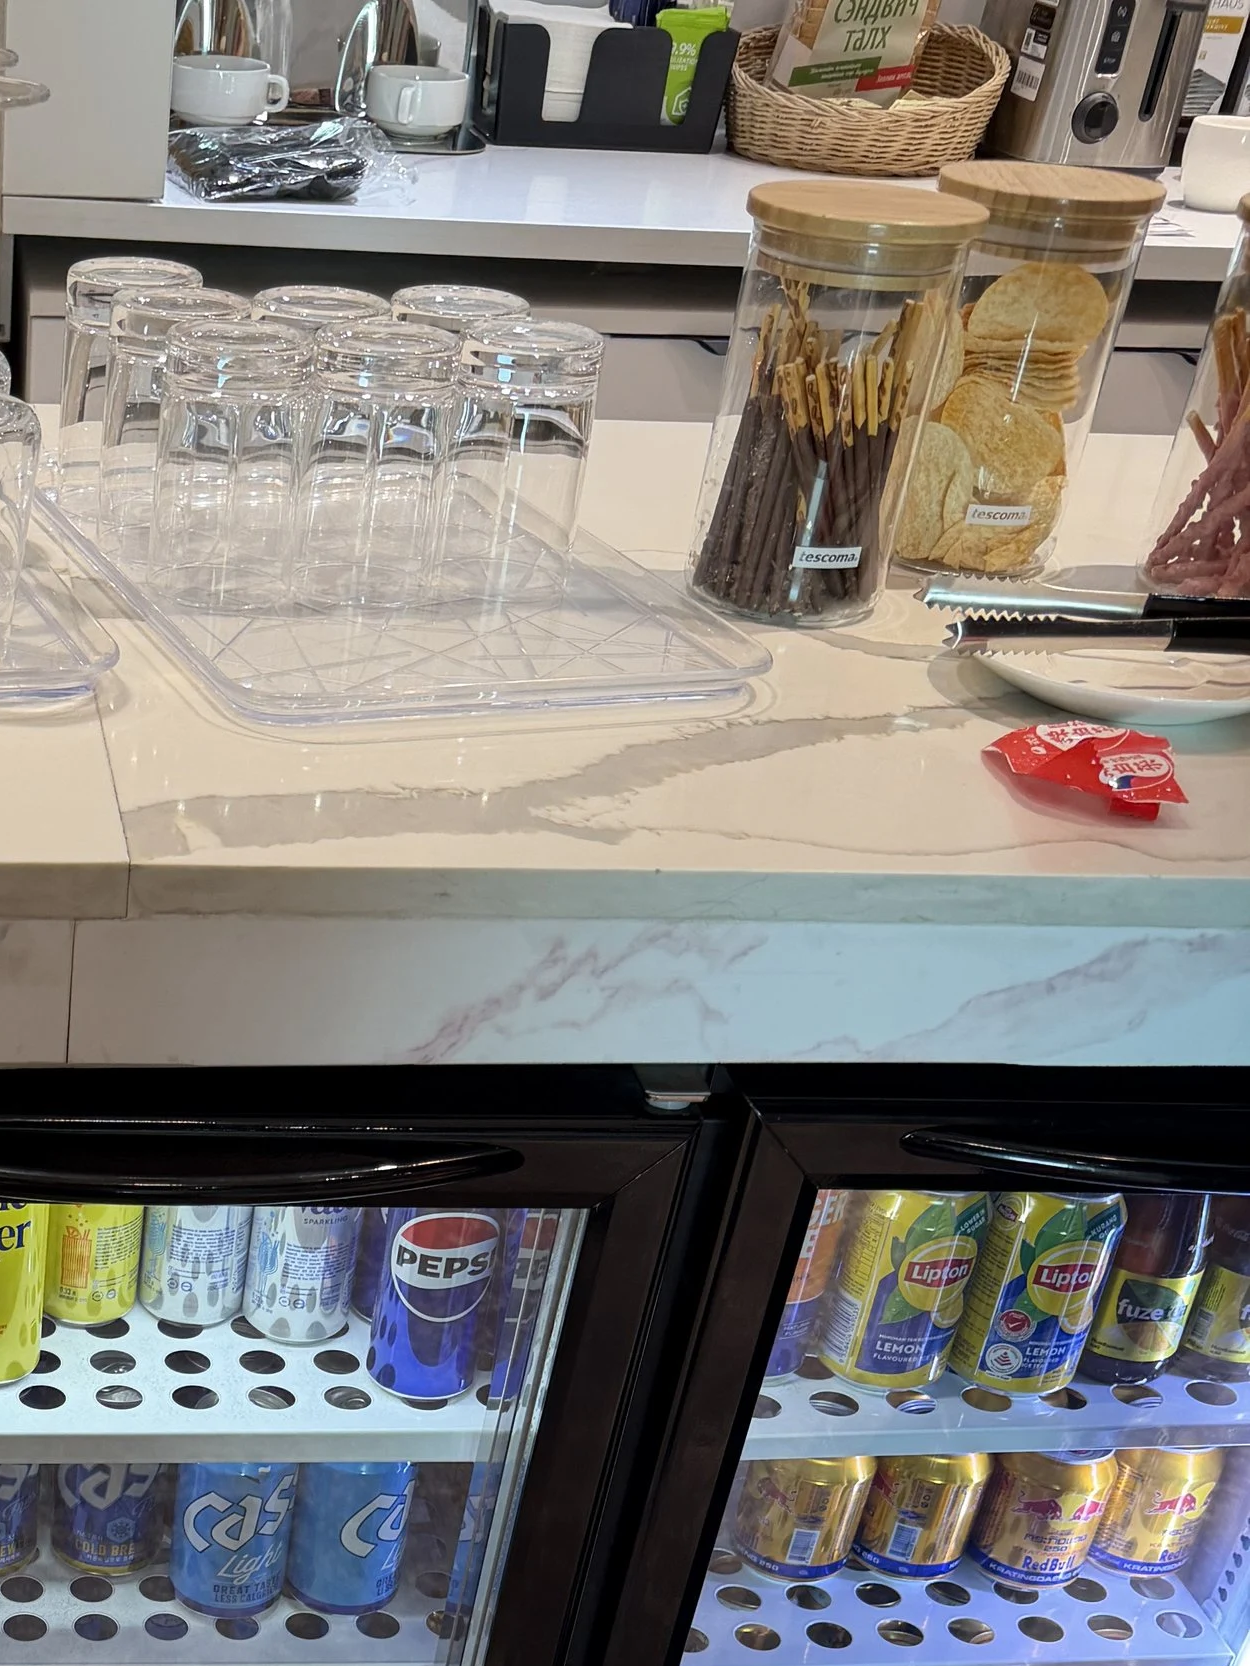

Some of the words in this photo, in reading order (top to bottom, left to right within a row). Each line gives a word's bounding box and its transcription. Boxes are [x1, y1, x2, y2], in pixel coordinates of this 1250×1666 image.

[971, 508, 1025, 521] tescoma
[798, 551, 856, 564] tescoma
[304, 1215, 348, 1225] SPARKLING
[912, 1263, 968, 1282] Lipton
[1117, 1299, 1164, 1321] fuze
[876, 1341, 925, 1354] LEMON
[1026, 1347, 1066, 1356] LEMON
[216, 1541, 282, 1585] Light
